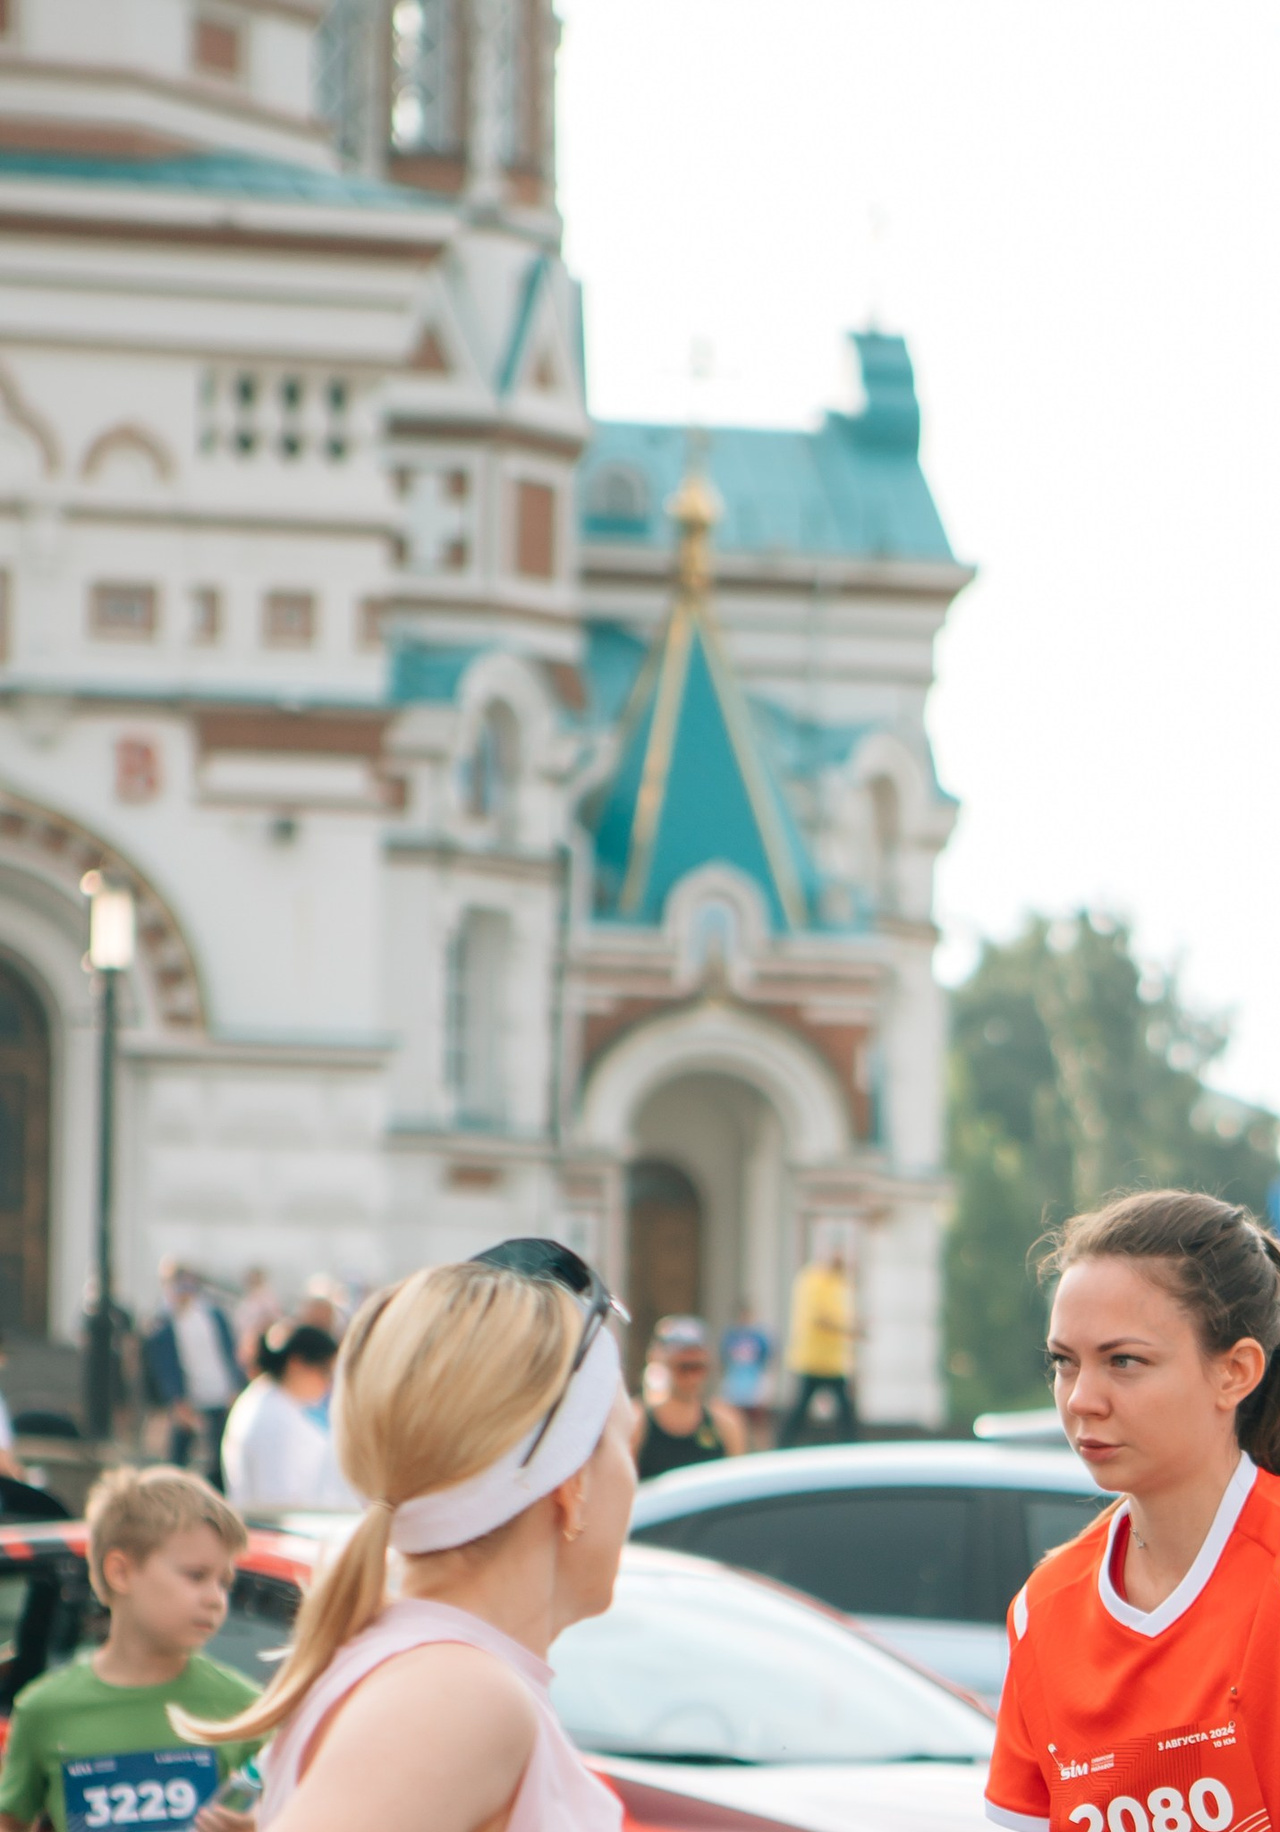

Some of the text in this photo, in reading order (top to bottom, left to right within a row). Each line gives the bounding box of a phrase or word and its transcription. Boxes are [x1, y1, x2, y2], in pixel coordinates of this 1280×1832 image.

[1157, 1726, 1235, 1751] 3 АВГУСТА 2024
[1212, 1739, 1222, 1748] 10
[83, 1778, 197, 1828] 3229
